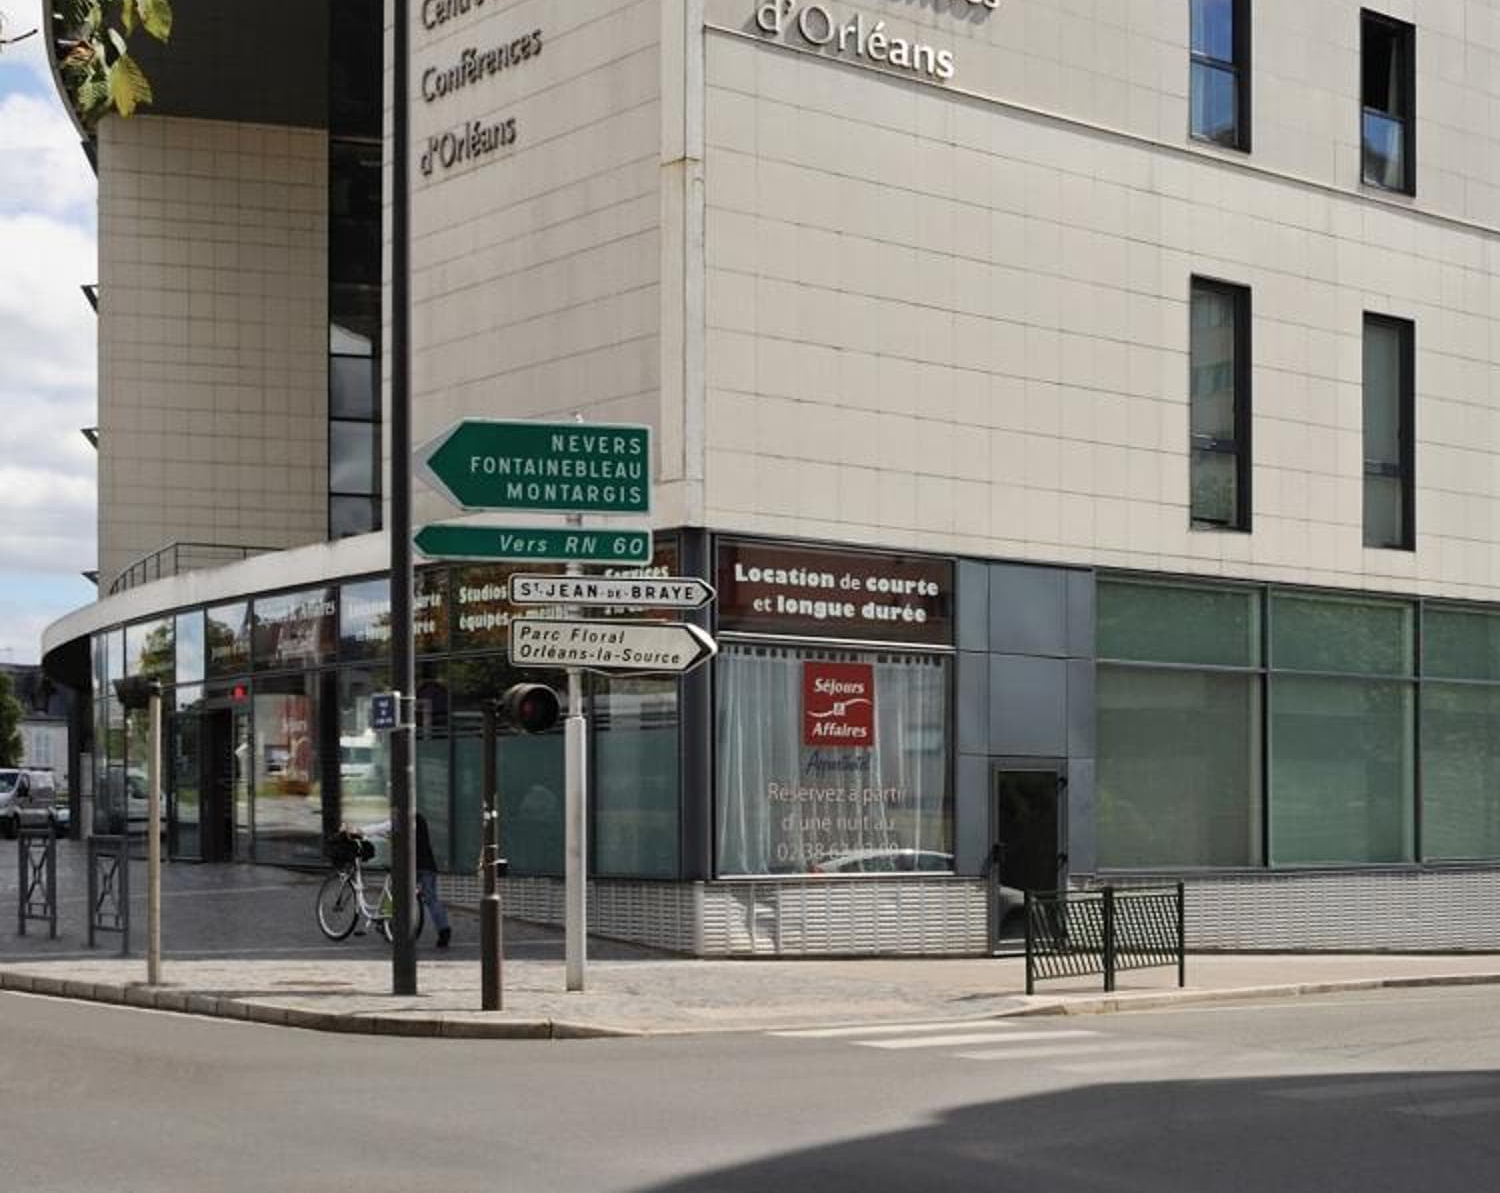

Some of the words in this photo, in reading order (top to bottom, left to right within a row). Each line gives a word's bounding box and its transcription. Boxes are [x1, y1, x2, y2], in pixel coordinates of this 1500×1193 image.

[420, 25, 543, 104] Conférences
[419, 114, 518, 177] d'Orléans
[550, 434, 642, 455] NEVERS
[470, 456, 642, 479] FONTAINEBLEAU
[506, 482, 642, 504] MONTARGIS
[500, 534, 548, 552] Vers
[564, 536, 597, 554] RN
[613, 537, 644, 554] 60
[734, 563, 835, 588] Location
[839, 573, 861, 590] de
[865, 575, 939, 596] courte
[458, 584, 508, 605] Studios
[753, 597, 773, 612] et
[776, 595, 856, 620] longue
[861, 602, 928, 623] durée
[519, 626, 560, 643] Parc
[570, 628, 626, 644] Floral
[519, 644, 682, 665] Orléans-la-Source
[813, 678, 865, 696] Séjours
[811, 722, 868, 739] Affaires
